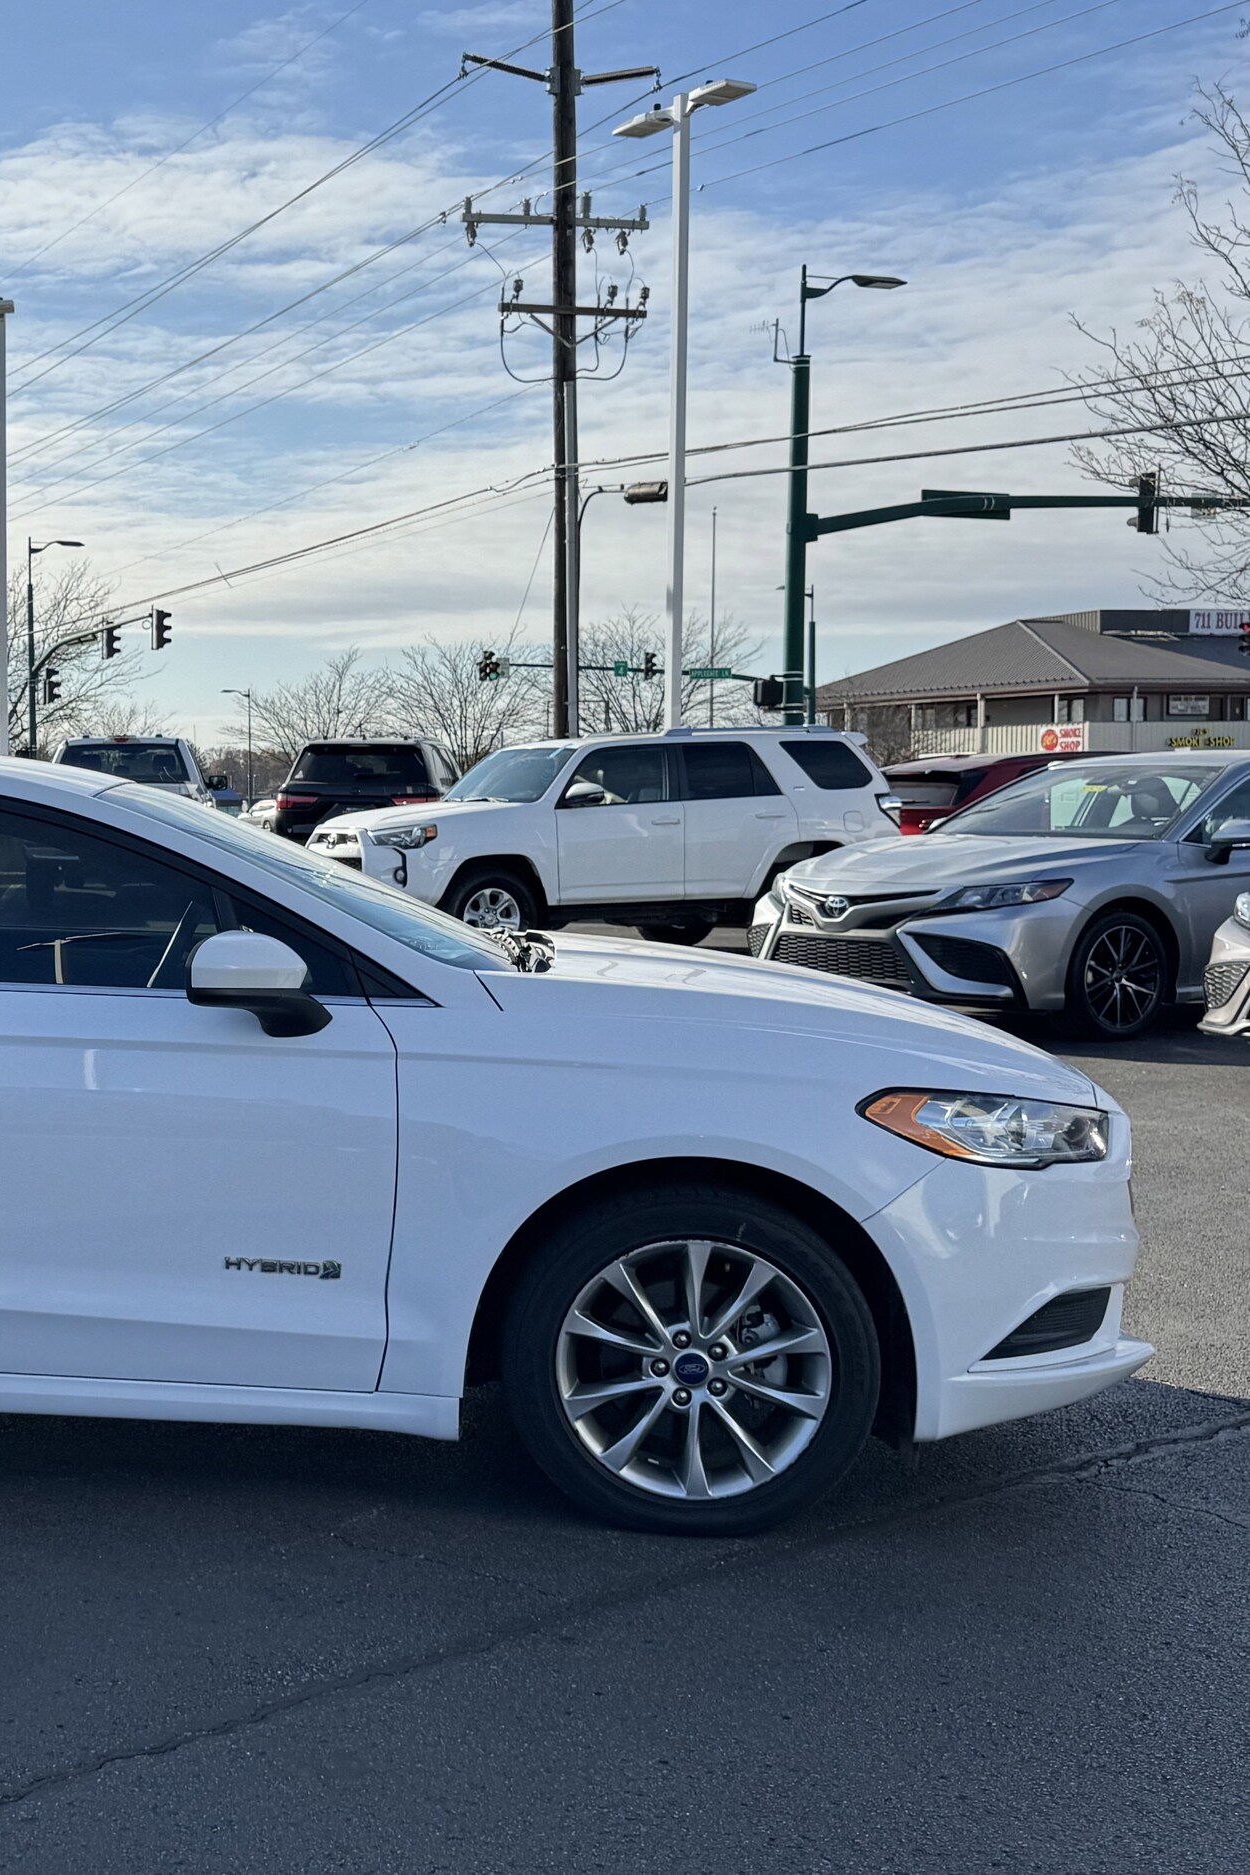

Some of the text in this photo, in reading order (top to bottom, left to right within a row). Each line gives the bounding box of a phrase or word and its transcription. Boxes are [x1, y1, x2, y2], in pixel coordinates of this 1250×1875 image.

[1195, 612, 1250, 630] 711 BUIL
[1060, 740, 1081, 751] SHOP
[1169, 736, 1204, 748] SMOK
[224, 1257, 321, 1276] HYBRID
